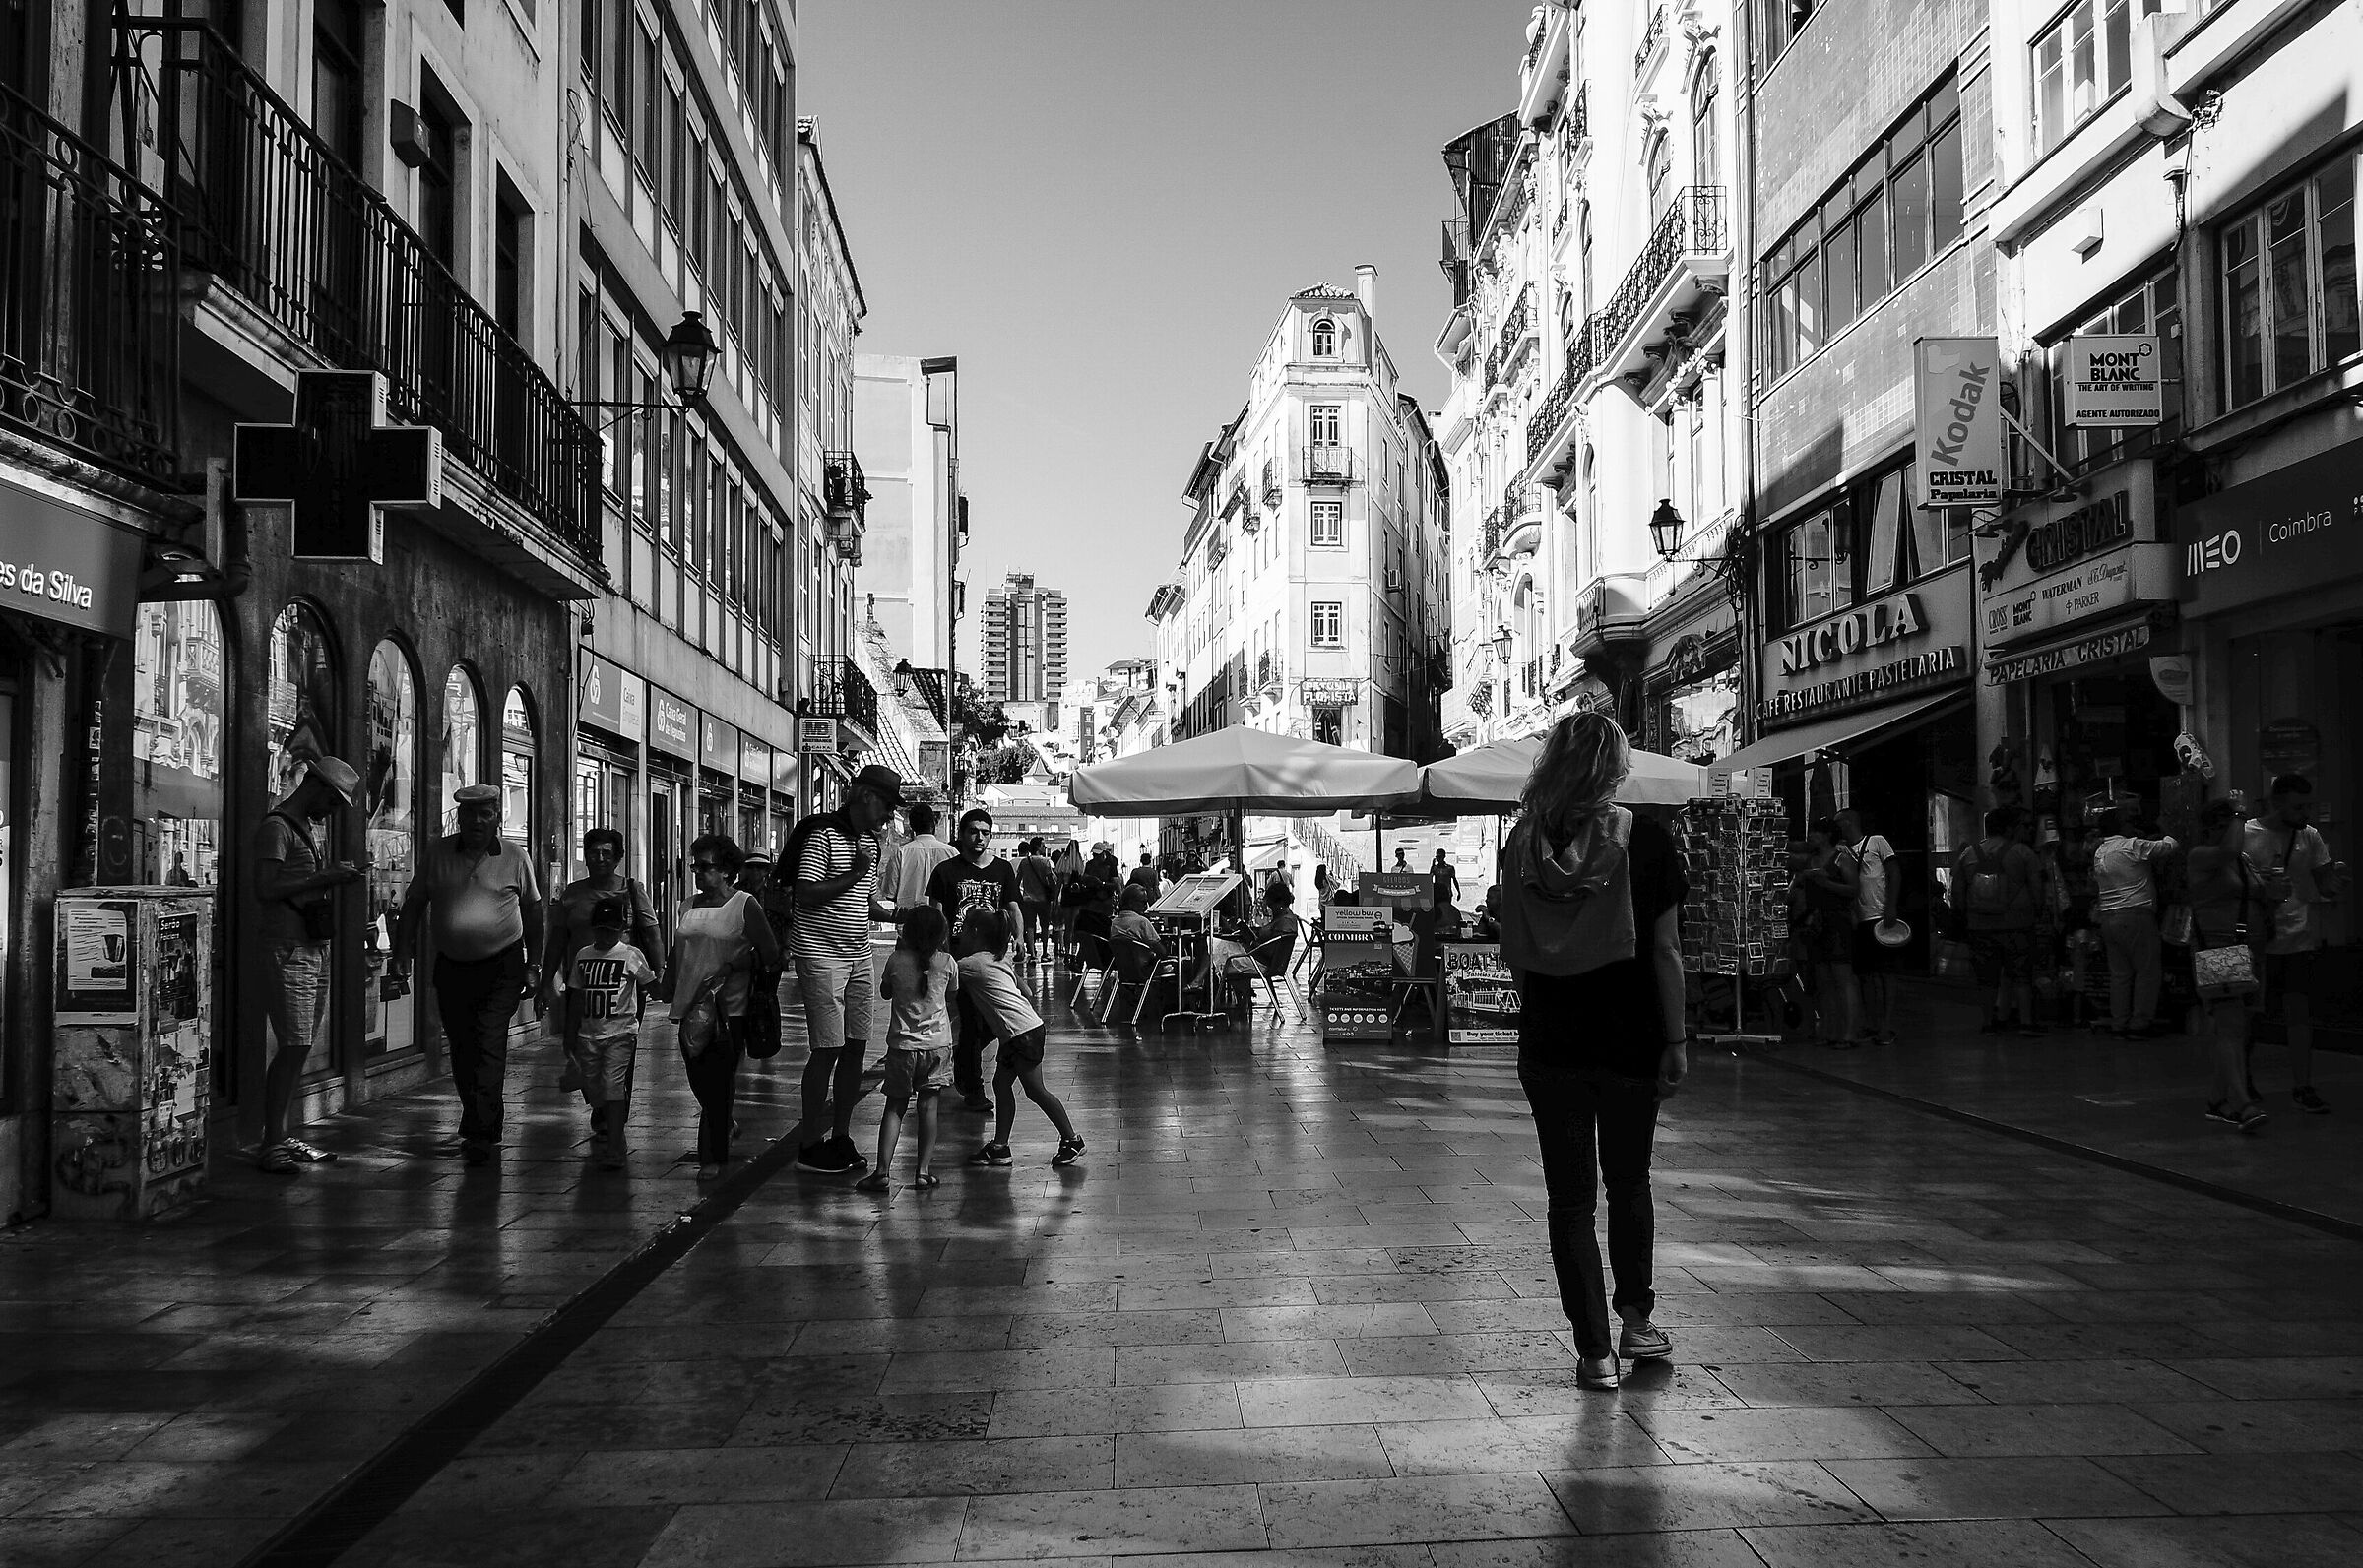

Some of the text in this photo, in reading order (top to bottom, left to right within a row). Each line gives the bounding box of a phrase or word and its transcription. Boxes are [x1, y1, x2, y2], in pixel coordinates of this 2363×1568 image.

[2089, 353, 2139, 367] MONT
[2090, 367, 2140, 381] BLANC
[1931, 362, 1990, 466] Kodak
[2076, 409, 2160, 418] AGENTE AUTORIZADO
[1930, 470, 1998, 486] CRISTAL
[1931, 488, 1997, 502] Papelaria
[2026, 491, 2131, 572] CRISTAL
[2269, 510, 2331, 543] Coimbra
[2187, 530, 2241, 577] MEO
[19, 563, 44, 595] da
[48, 570, 92, 608] Silva
[2041, 577, 2081, 600] WATERMAN
[2013, 599, 2031, 615] MONT
[2075, 592, 2099, 610] PARKER
[2013, 610, 2032, 627] BLANC
[1779, 593, 1924, 676] NICOLA
[1990, 627, 2148, 684] PAPELARIA CRISTAL
[1784, 673, 1863, 714] RESTAURANTE
[1870, 646, 1954, 691] PASTELARIA
[1303, 690, 1356, 703] FLORISTA
[1328, 933, 1374, 942] COIMBRA
[1447, 952, 1489, 972] BOAT
